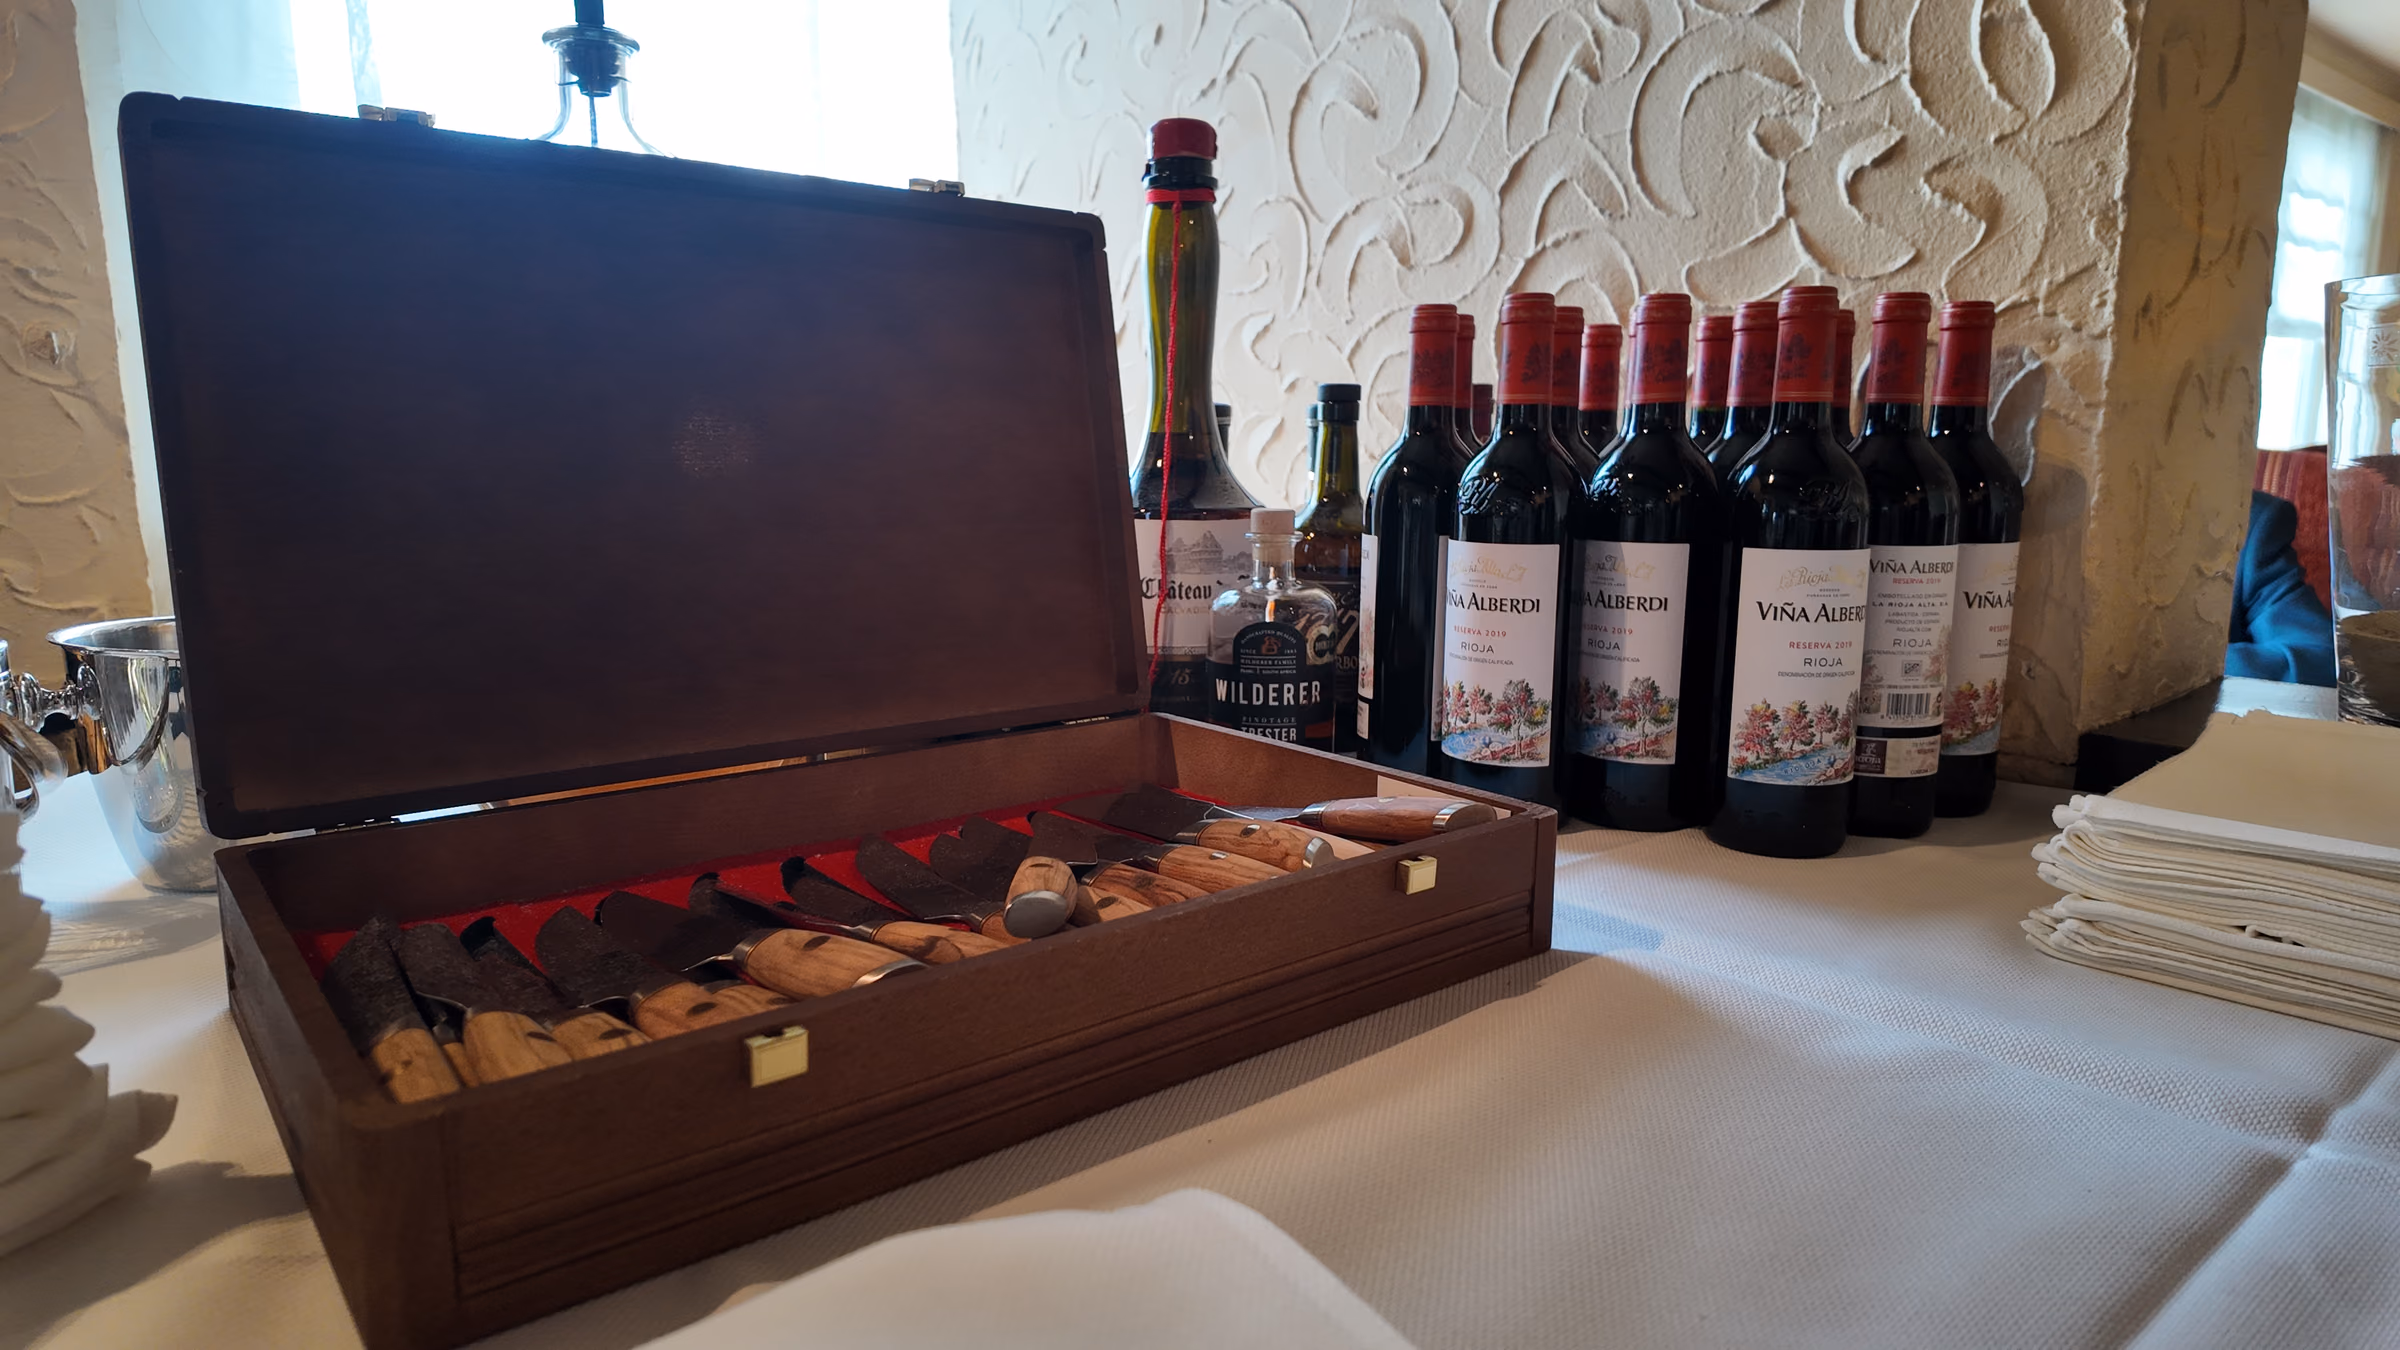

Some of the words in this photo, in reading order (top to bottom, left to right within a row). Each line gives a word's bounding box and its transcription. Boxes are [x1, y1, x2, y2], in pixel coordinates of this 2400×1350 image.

[1869, 558, 1907, 574] VIÑA
[1140, 576, 1213, 600] Câteau
[1467, 592, 1541, 614] ALBERDI
[1594, 589, 1669, 612] ALBERDI
[1962, 590, 2003, 609] VIÑA
[1756, 601, 1810, 623] VIÑA
[1814, 603, 1866, 623] ALBERD
[1485, 630, 1507, 638] 2019
[1612, 627, 1633, 635] 2019
[1460, 641, 1495, 654] RIOJA
[1587, 639, 1621, 651] RIOJA
[1789, 642, 1832, 650] RESERVA
[1892, 638, 1932, 648] RIOJA
[1803, 657, 1843, 667] RIOJA
[1215, 678, 1321, 707] WILDERER
[1242, 716, 1297, 724] PINOTAGE
